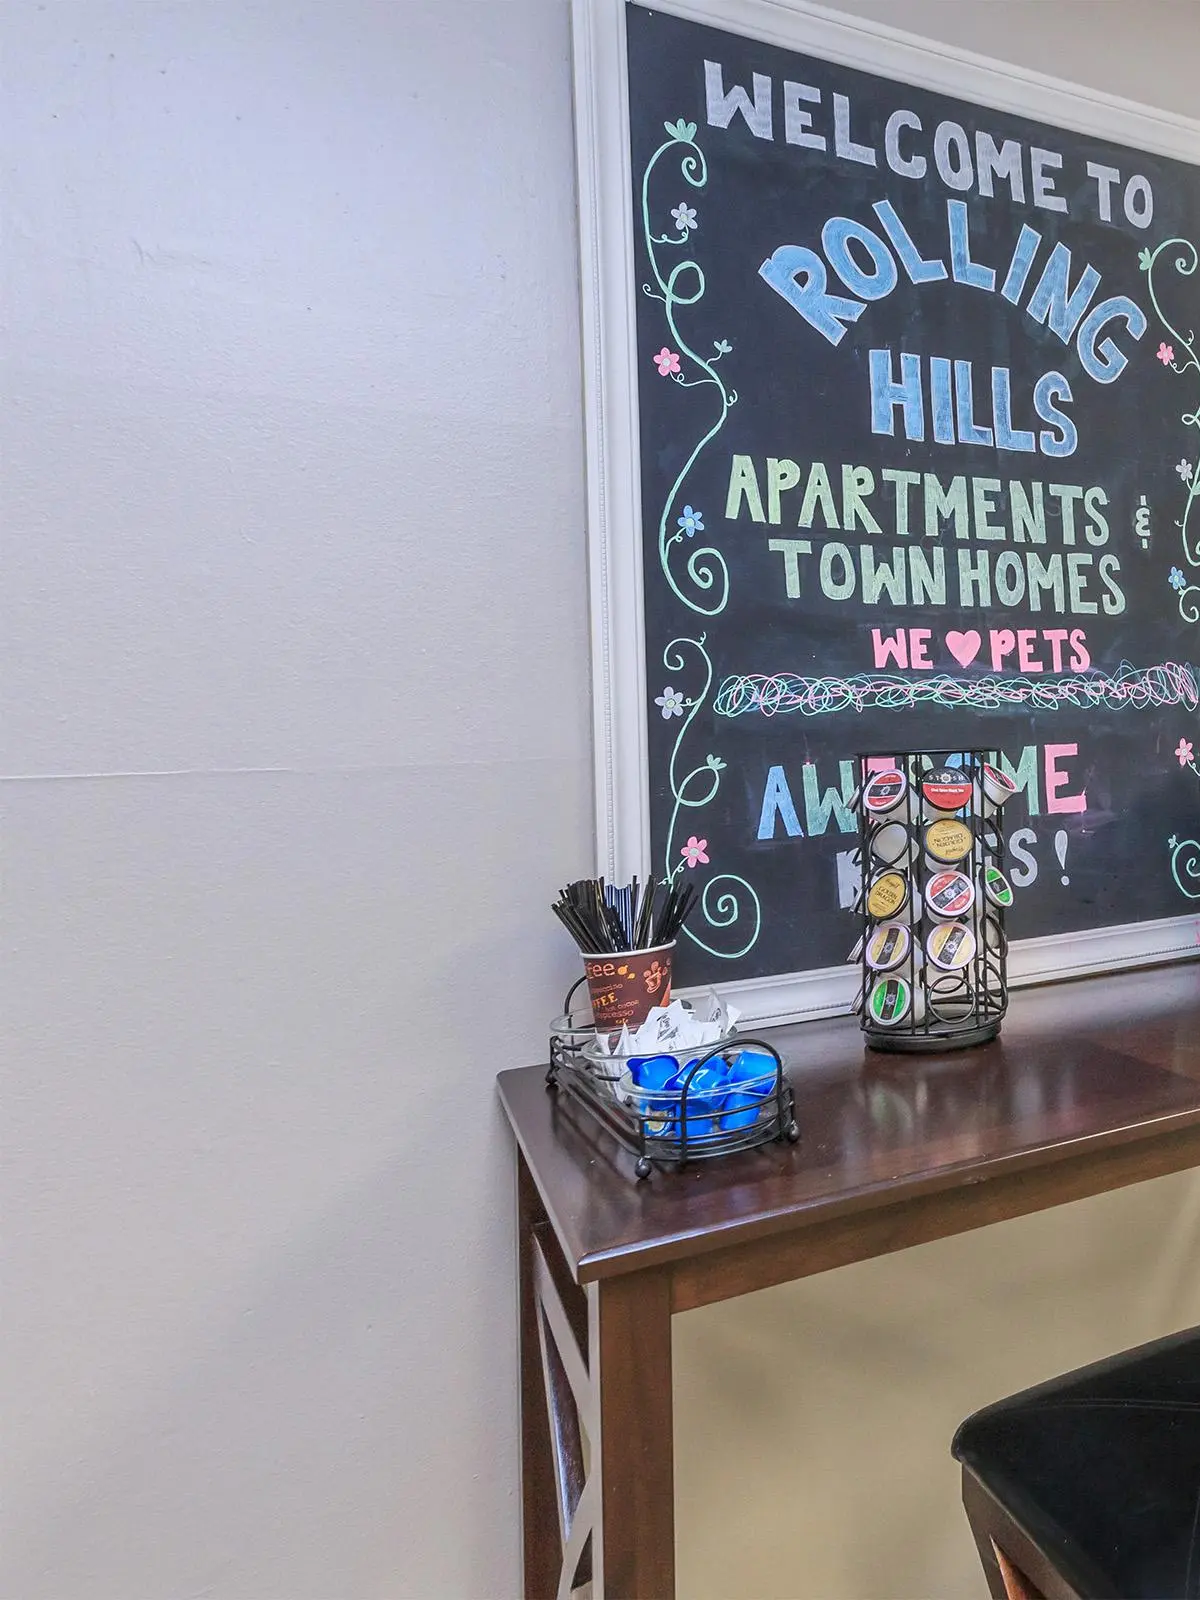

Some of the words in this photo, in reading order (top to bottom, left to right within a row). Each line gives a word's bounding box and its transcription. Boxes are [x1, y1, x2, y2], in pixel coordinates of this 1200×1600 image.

[703, 58, 1070, 215] WELCOME
[1086, 160, 1155, 230] TO
[757, 199, 1148, 385] ROLLING
[869, 349, 1079, 458] HILLS
[724, 454, 1112, 548] APARTMENTS
[871, 628, 934, 670] WE
[990, 628, 1092, 674] PETS
